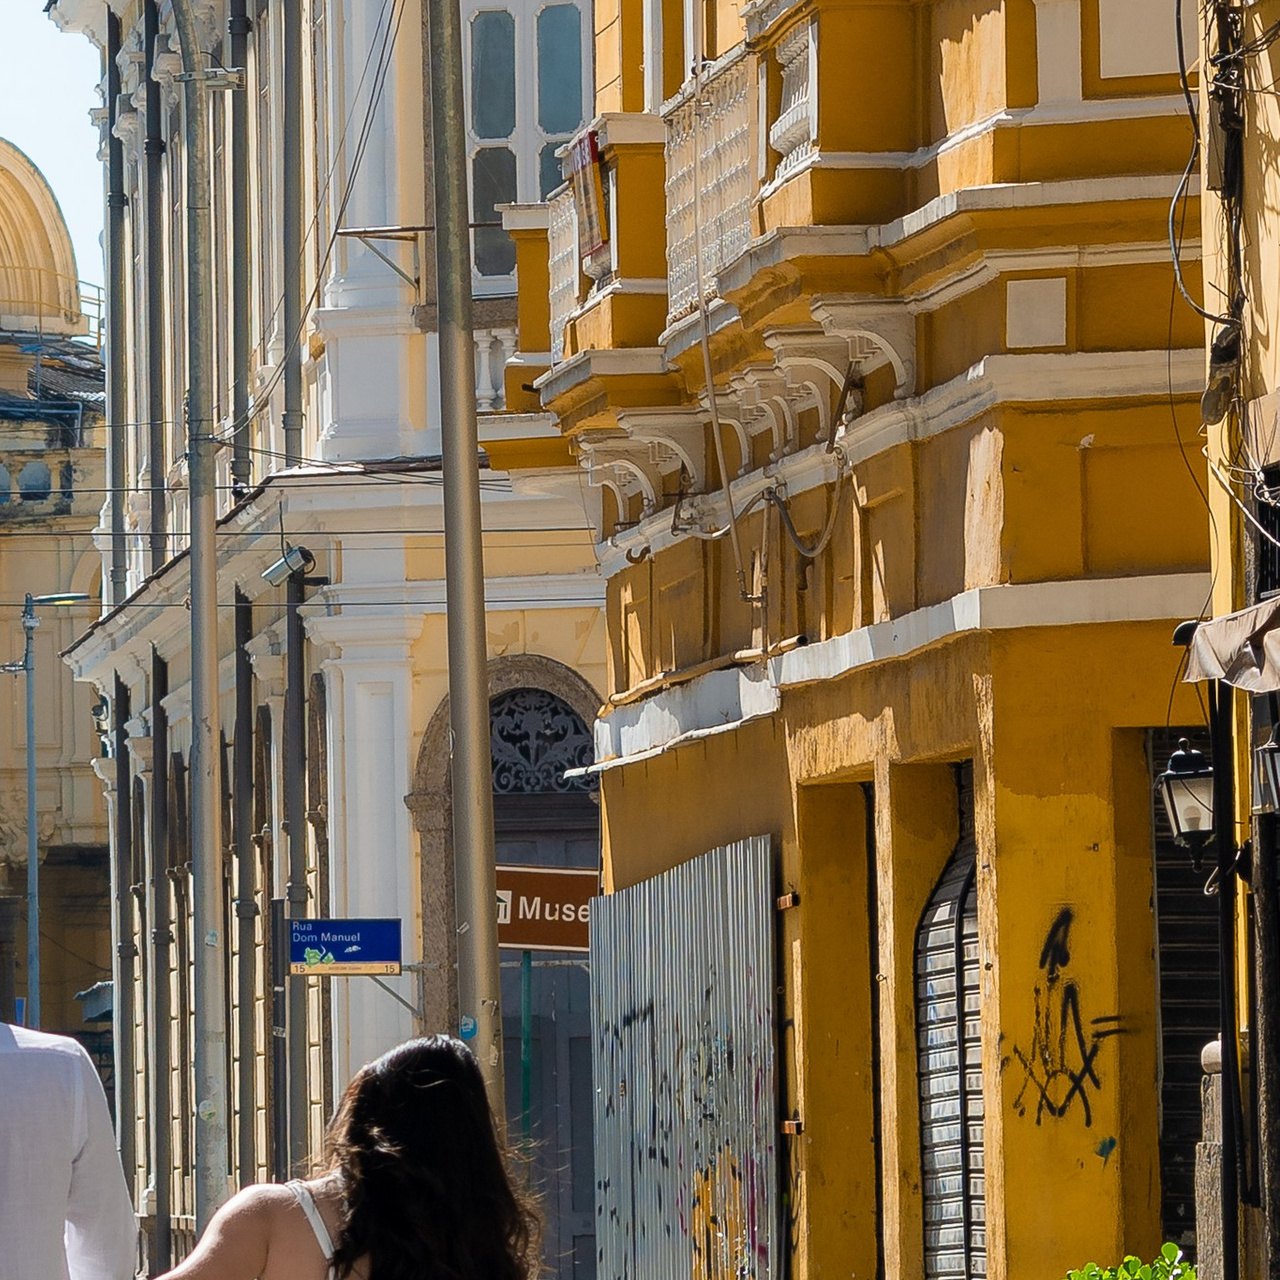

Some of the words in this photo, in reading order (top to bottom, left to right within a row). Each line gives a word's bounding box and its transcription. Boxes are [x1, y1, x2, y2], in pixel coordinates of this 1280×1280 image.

[292, 921, 312, 931] Rua
[292, 933, 318, 942] Dom
[321, 932, 361, 942] Manuel
[294, 965, 305, 973] 15
[384, 965, 395, 973] 15
